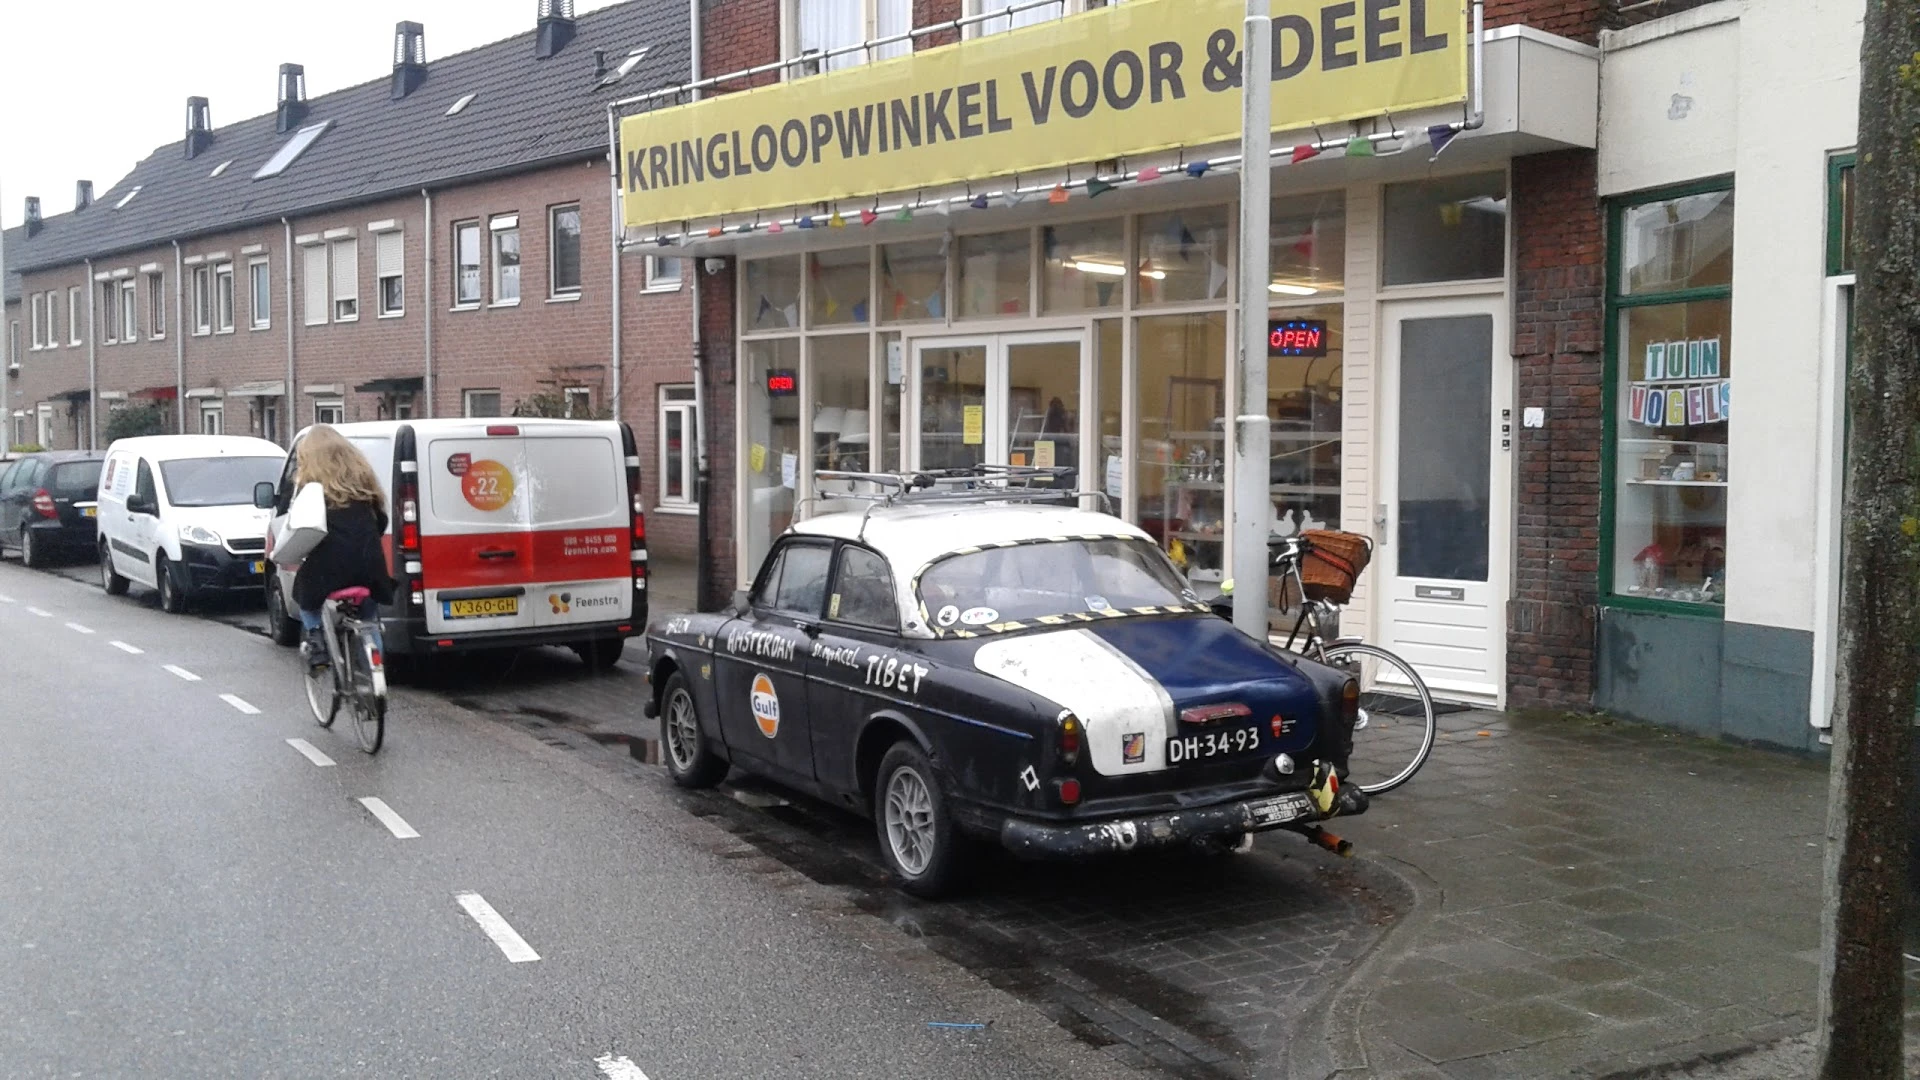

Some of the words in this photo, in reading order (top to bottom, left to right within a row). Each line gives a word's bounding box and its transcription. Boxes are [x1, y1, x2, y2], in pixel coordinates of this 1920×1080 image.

[628, 79, 1012, 193] KRINGLOOPWINKEL
[1021, 41, 1185, 125] VOOR
[1202, 28, 1243, 92] &
[1271, 0, 1448, 81] DEEL
[1270, 331, 1320, 348] OPEN
[1649, 342, 1718, 377] TUIN
[769, 377, 793, 390] OPEN
[455, 599, 514, 613] V-360-GH
[576, 596, 619, 608] Feenstra
[727, 628, 796, 662] AMSTERDAM
[753, 696, 778, 717] Gulf
[1170, 727, 1260, 763] DH-34-93
